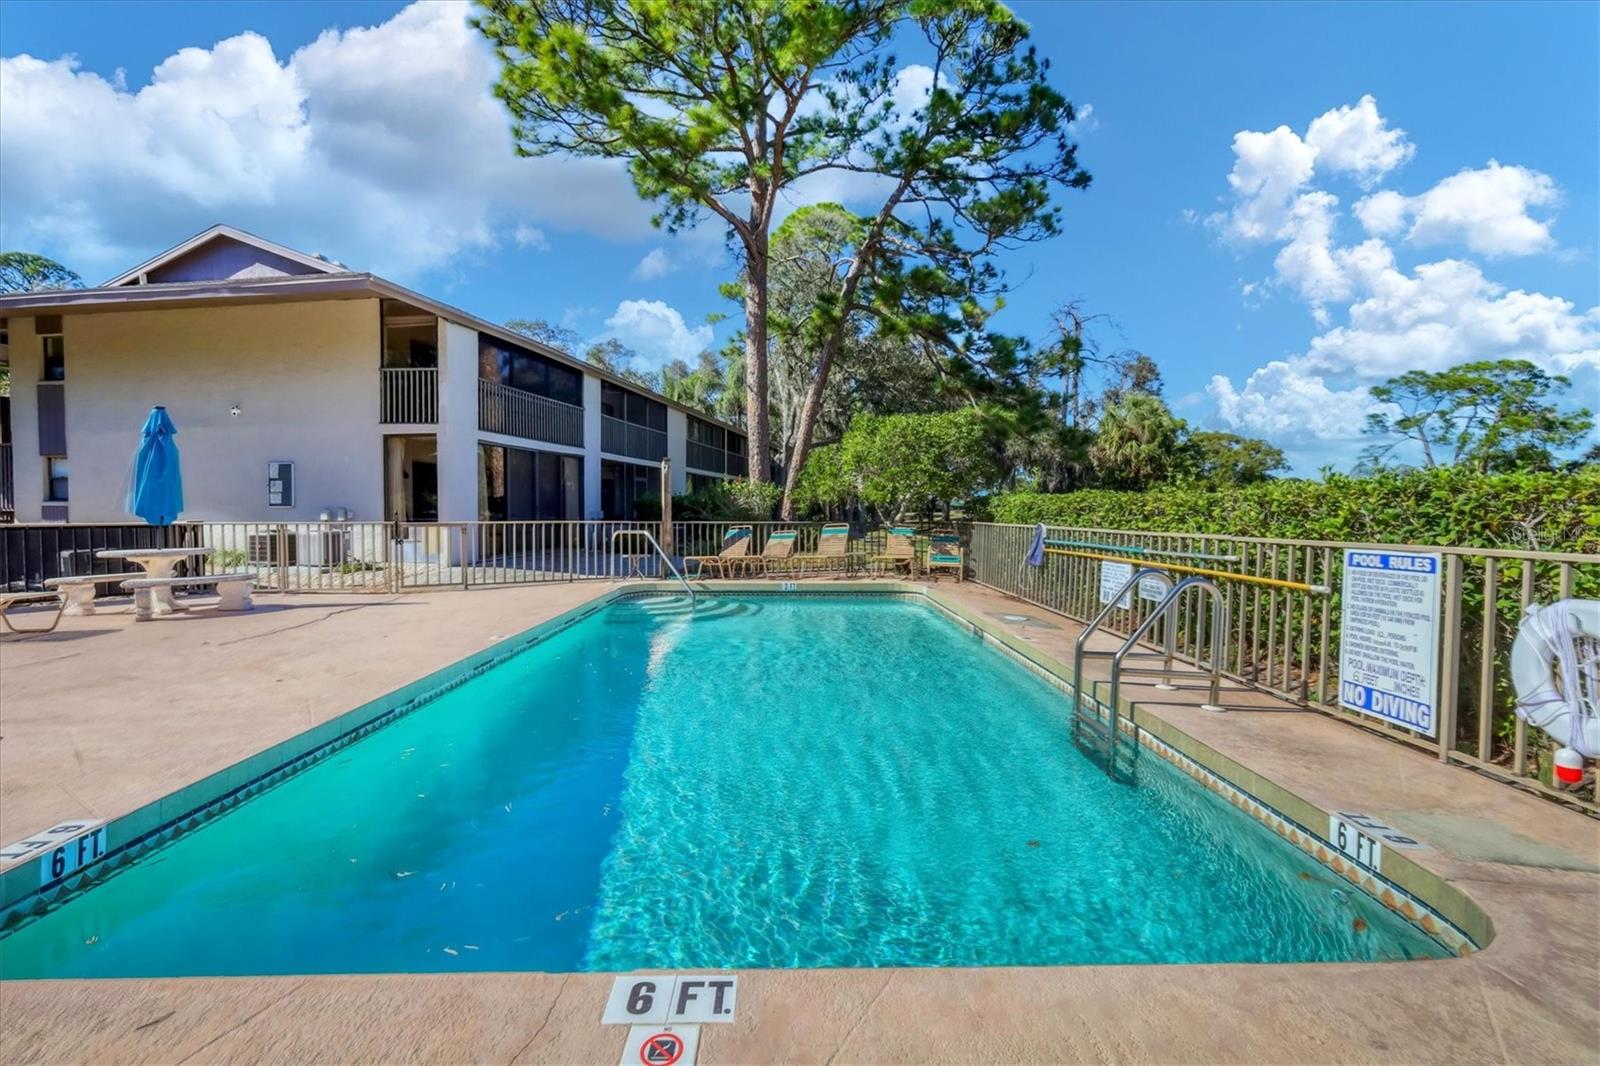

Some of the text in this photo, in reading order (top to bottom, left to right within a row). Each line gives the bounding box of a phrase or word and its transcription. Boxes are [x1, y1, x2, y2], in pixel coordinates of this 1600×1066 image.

[1352, 554, 1433, 572] POOL RULES
[1347, 657, 1366, 672] POOL
[1343, 681, 1431, 728] NO DIVING
[47, 824, 85, 834] 6
[1383, 834, 1419, 845] 6
[52, 828, 105, 879] 6 FT.
[1338, 821, 1378, 871] 6 FT.
[626, 980, 734, 1015] 6 FT.
